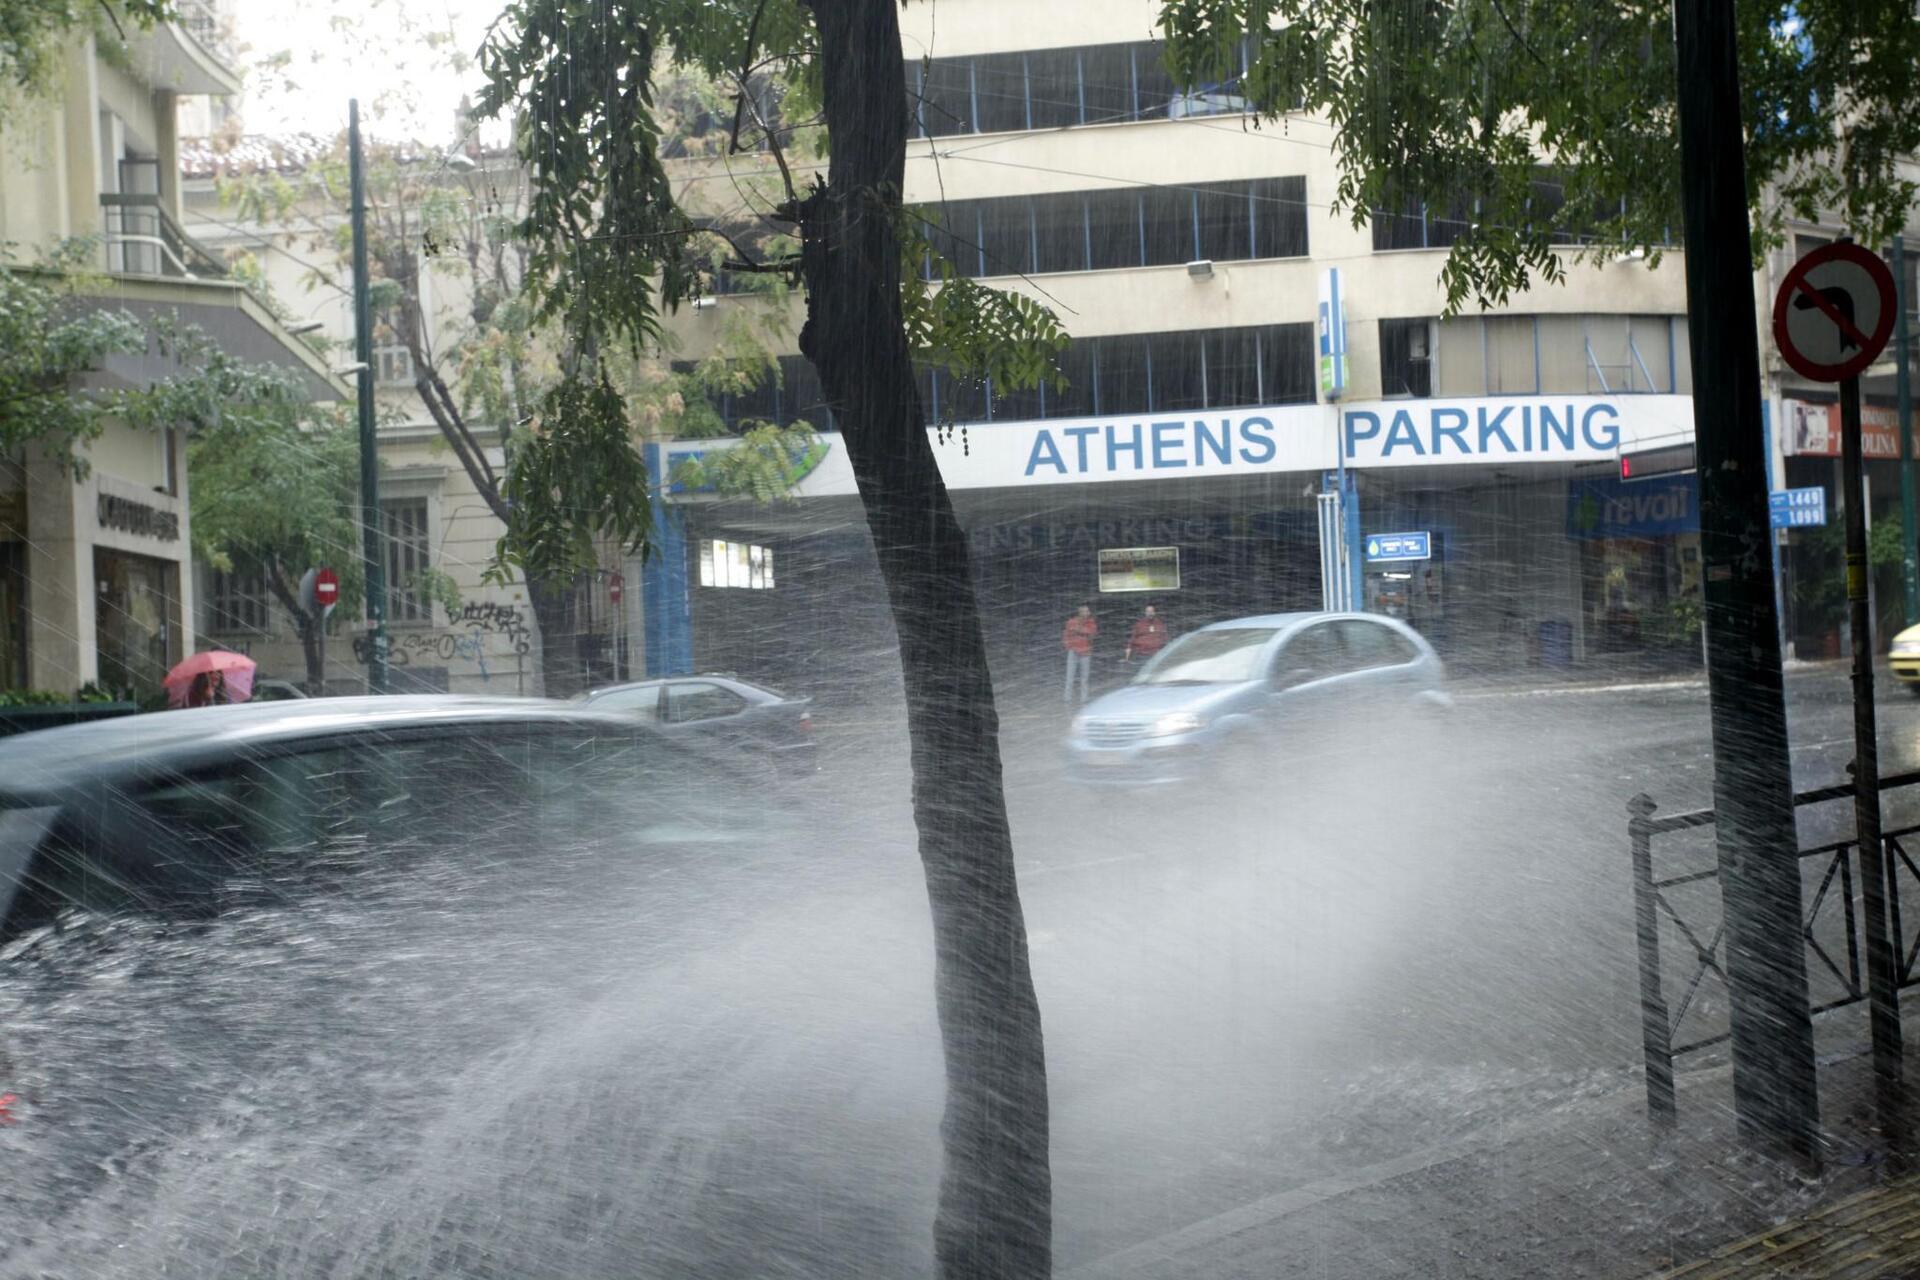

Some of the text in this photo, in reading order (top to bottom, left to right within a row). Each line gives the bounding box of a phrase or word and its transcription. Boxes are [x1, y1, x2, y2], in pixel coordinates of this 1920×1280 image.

[1025, 403, 1621, 476] ATHENS PARKING
[1603, 485, 1689, 525] revoil
[1049, 517, 1214, 549] PARKING
